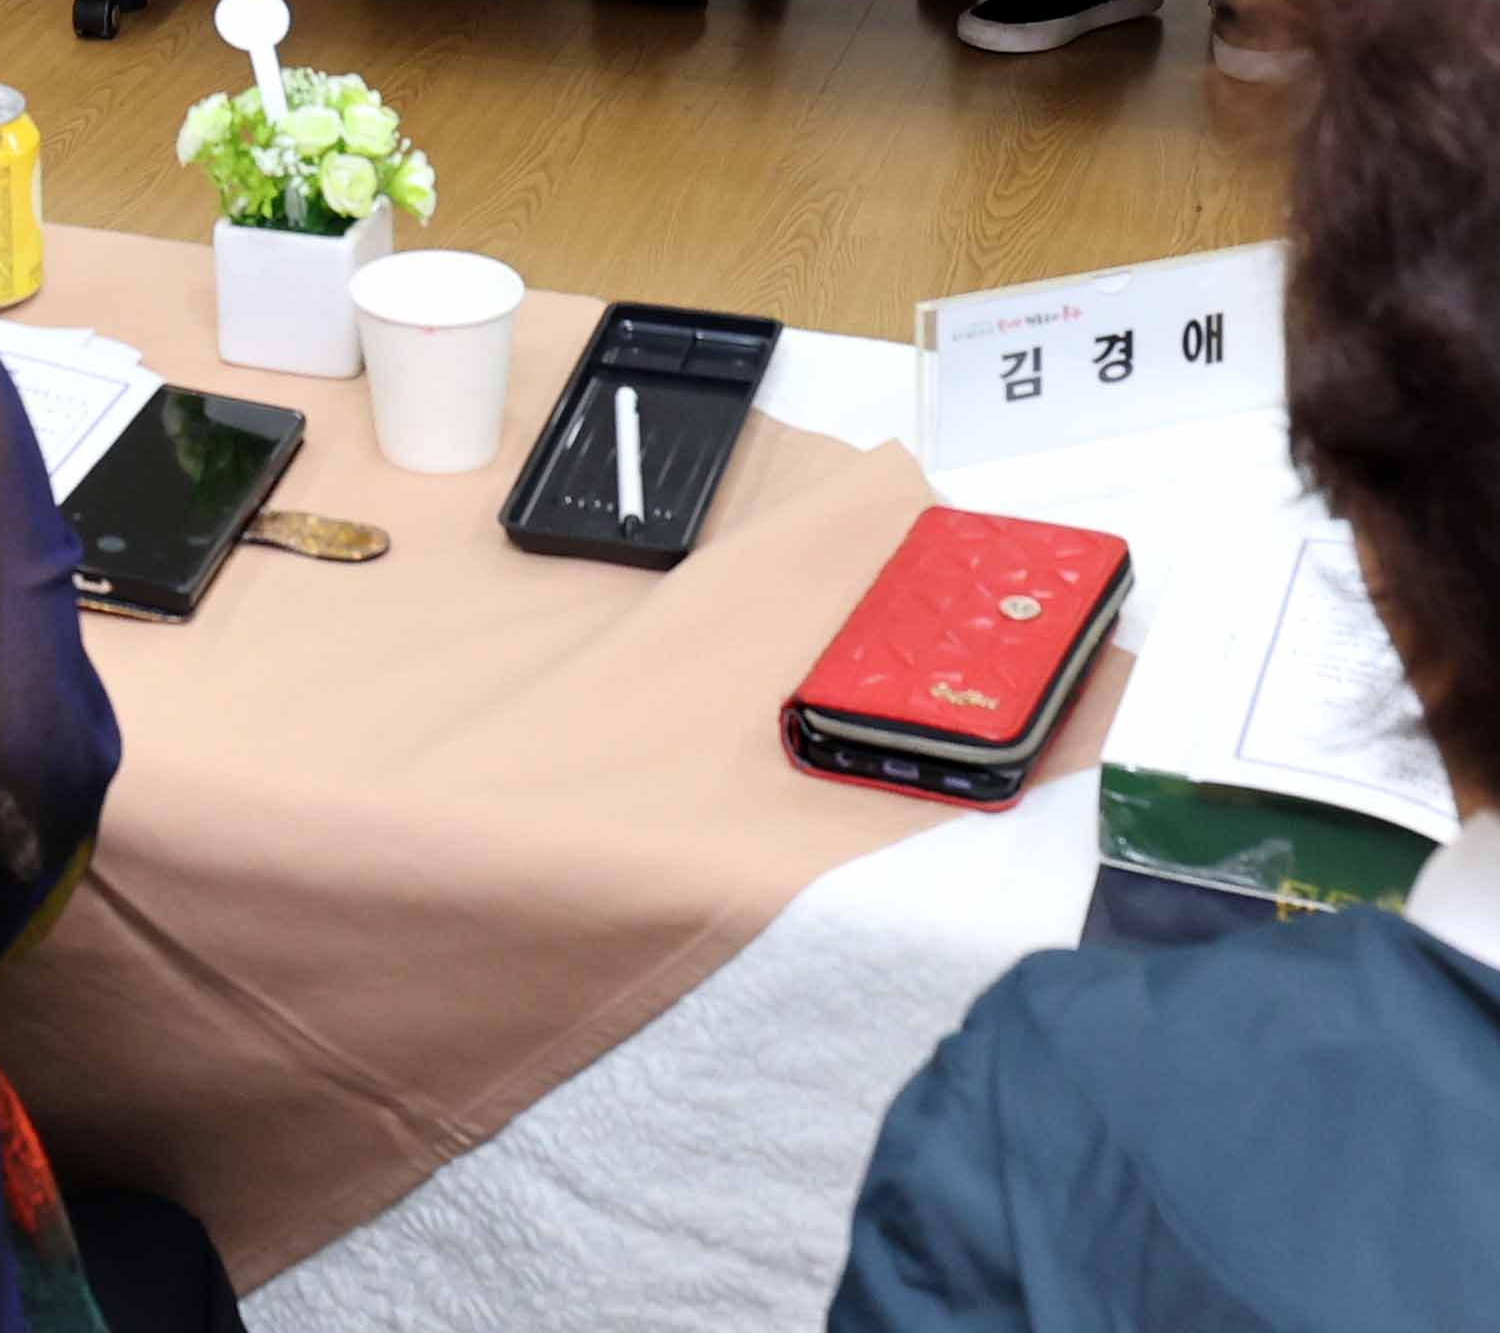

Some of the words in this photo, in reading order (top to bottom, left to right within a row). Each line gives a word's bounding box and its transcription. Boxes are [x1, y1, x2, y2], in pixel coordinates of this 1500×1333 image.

[999, 345, 1043, 403] 김
[1091, 328, 1134, 384] 경
[1181, 311, 1225, 366] 애
